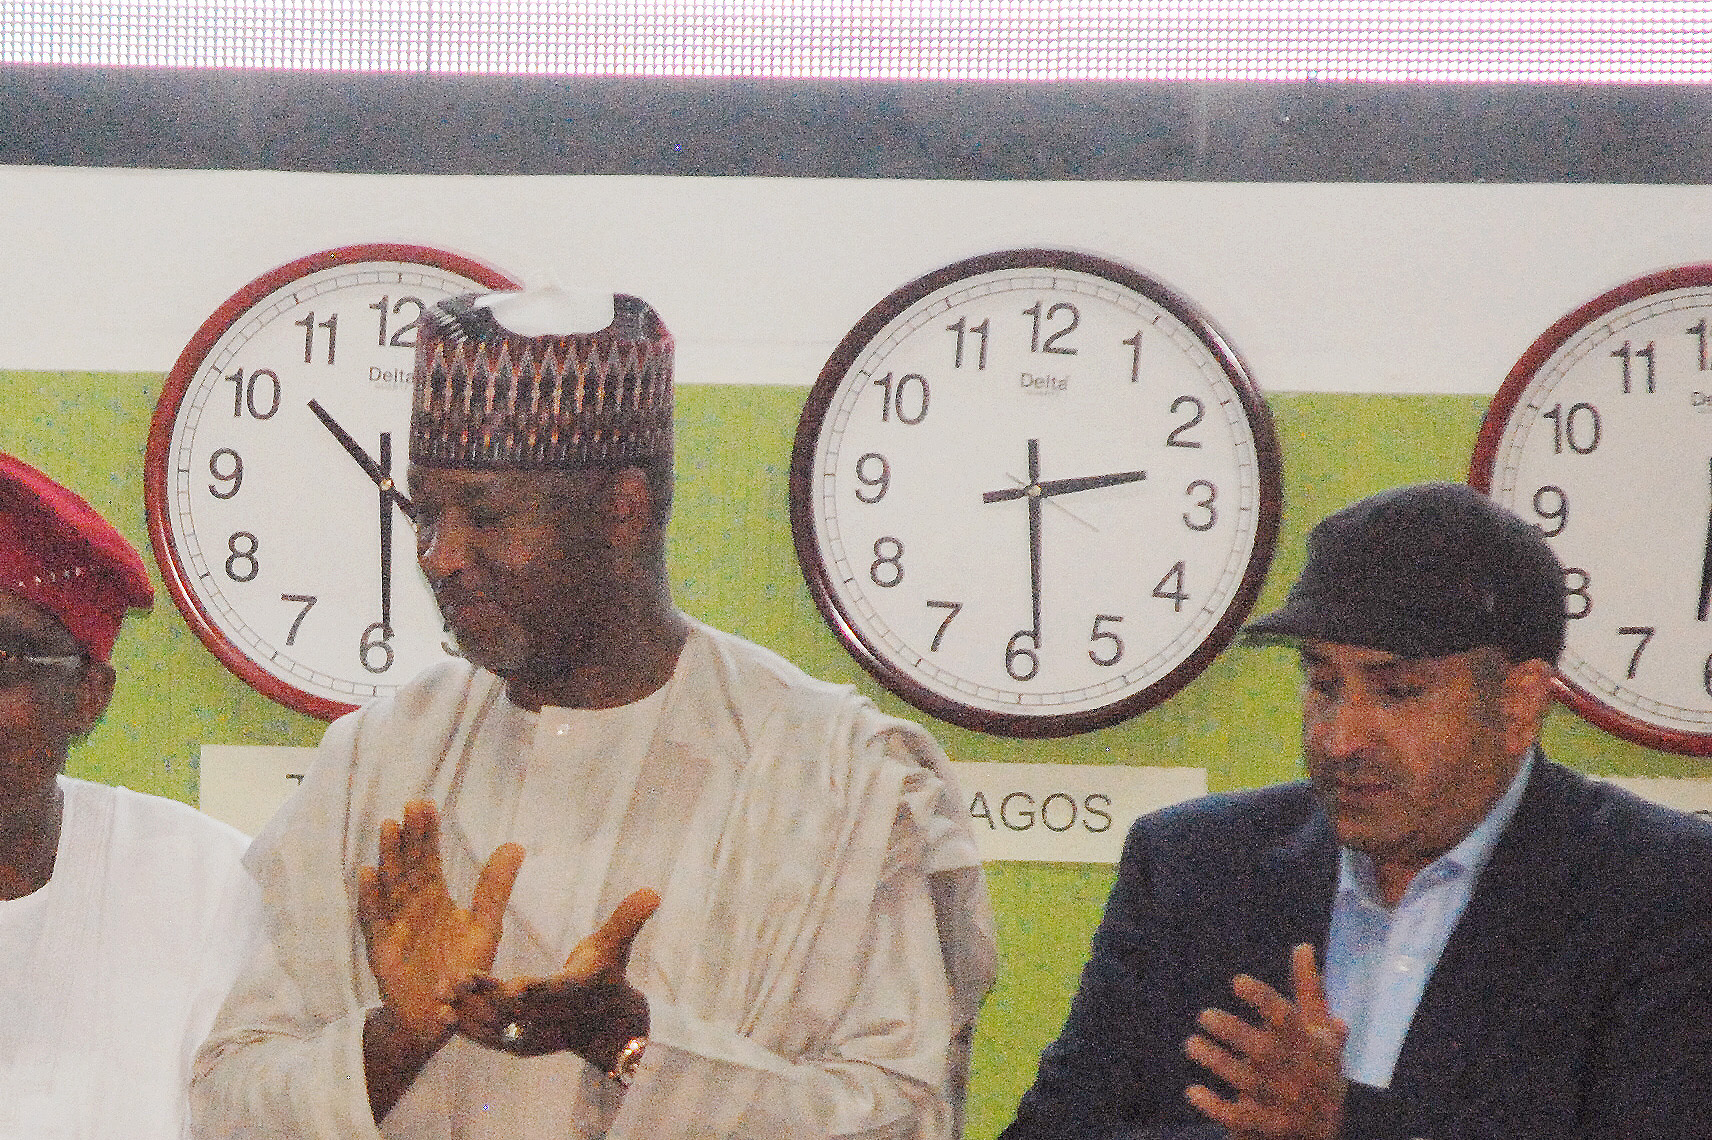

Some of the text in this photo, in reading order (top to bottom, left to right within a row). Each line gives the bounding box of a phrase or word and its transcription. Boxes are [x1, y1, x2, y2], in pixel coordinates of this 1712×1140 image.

[295, 312, 337, 364] 11
[369, 296, 426, 347] 12
[946, 317, 989, 369] 11
[1023, 301, 1081, 356] 12
[1686, 318, 1712, 371] 1
[1020, 372, 1068, 391] Delta
[1123, 330, 1143, 382] 1
[1611, 340, 1656, 393] 11
[225, 368, 280, 420] 10
[874, 372, 929, 424] 10
[1167, 395, 1205, 448] 2
[1543, 402, 1602, 454] 10
[208, 448, 244, 500] 9
[855, 453, 890, 503] 9
[1183, 480, 1217, 531] 3
[1533, 485, 1569, 537] 9
[225, 531, 258, 582] 8
[871, 537, 905, 587] 8
[1152, 561, 1189, 612] 4
[1562, 567, 1592, 620] 8
[281, 594, 317, 645] 7
[927, 600, 962, 651] 7
[1089, 615, 1124, 666] 5
[359, 622, 394, 673] 6
[1005, 630, 1039, 681] 6
[1618, 626, 1655, 679] 7
